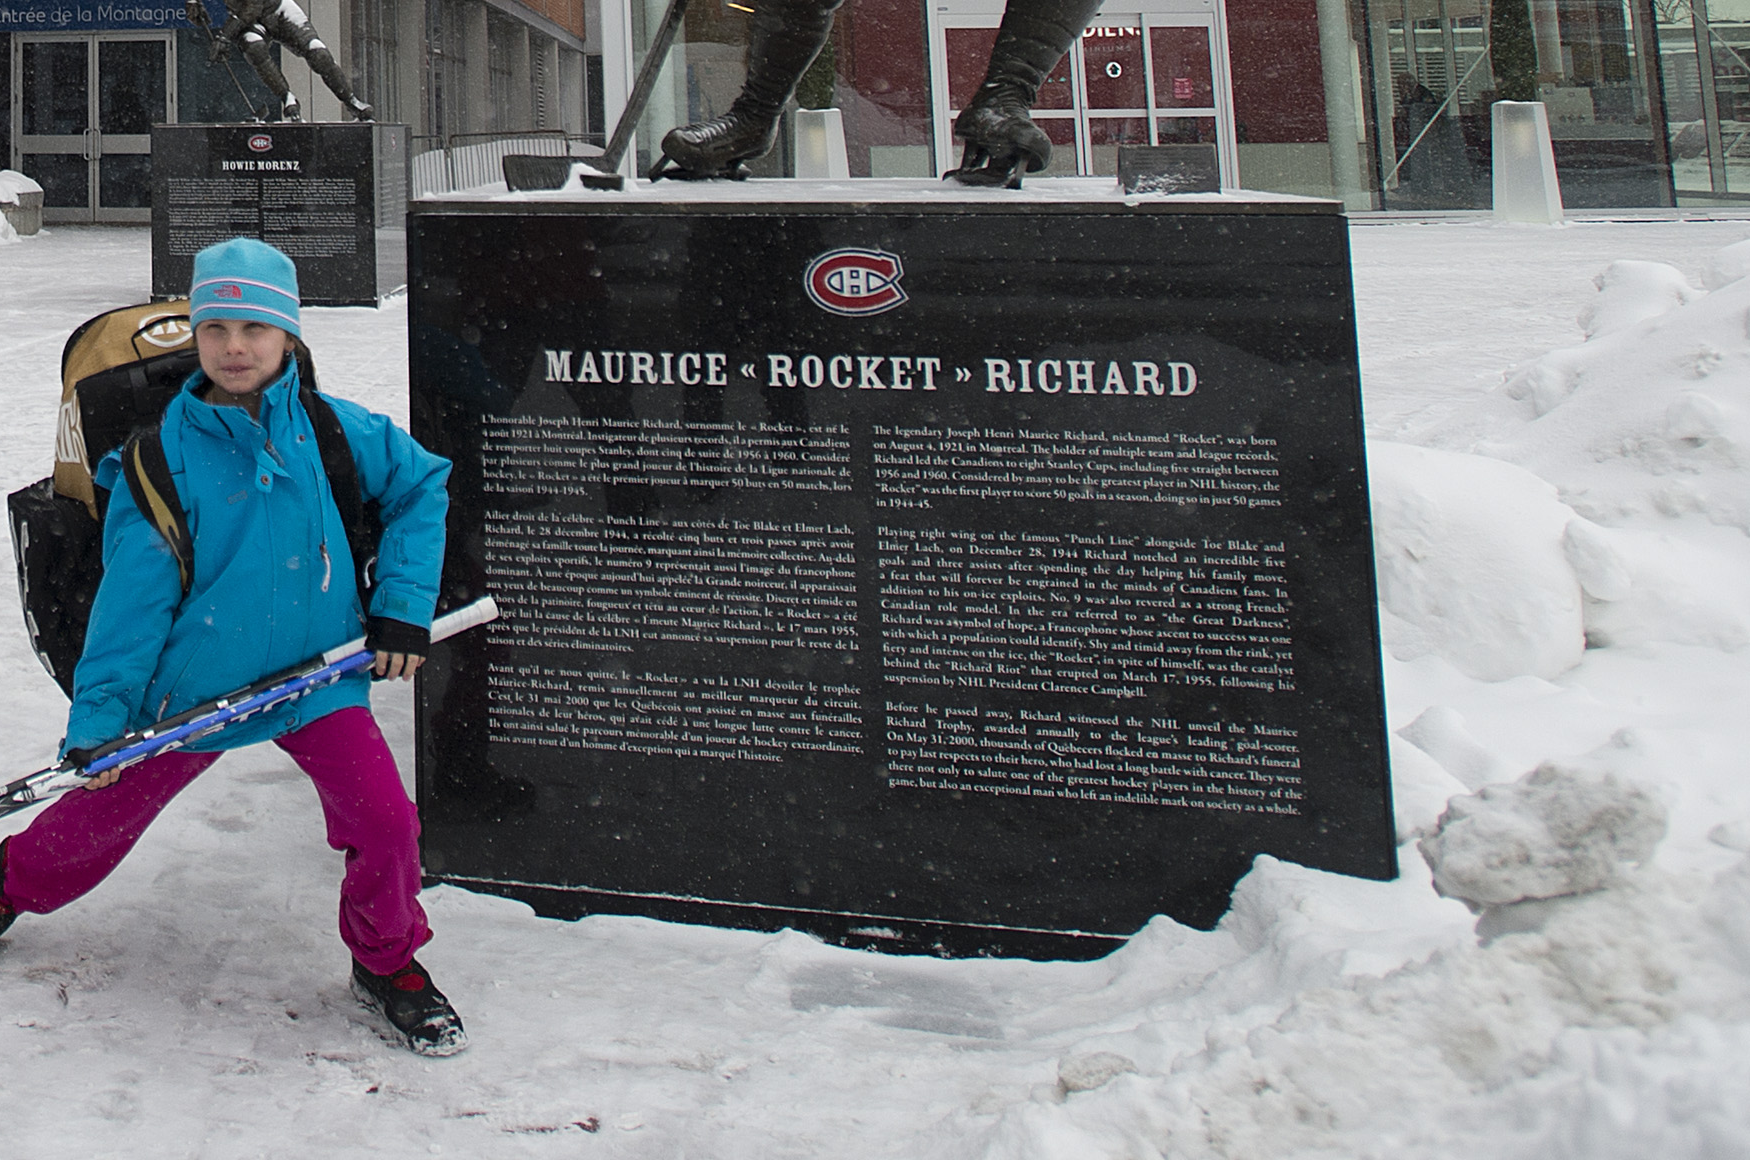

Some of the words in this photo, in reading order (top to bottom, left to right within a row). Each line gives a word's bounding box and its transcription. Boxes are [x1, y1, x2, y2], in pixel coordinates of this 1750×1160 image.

[51, 6, 72, 23] de
[77, 5, 92, 22] la
[97, 5, 187, 26] Montagne
[222, 160, 256, 171] HOWIE
[257, 160, 300, 172] MORENZ
[545, 350, 728, 386] MAURICE
[767, 354, 942, 391] ROCKET
[984, 358, 1198, 397] RICHARD
[538, 415, 569, 428] Joseph
[572, 417, 598, 426] Henri
[602, 417, 639, 428] Maurice
[684, 420, 734, 430] surnommé
[736, 421, 746, 431] le
[759, 422, 792, 432] Rocket
[808, 424, 822, 433] est
[825, 424, 837, 433] né
[840, 424, 849, 434] le
[872, 425, 891, 435] The
[894, 426, 943, 439] legendary
[946, 427, 980, 440] Joseph
[984, 428, 1014, 438] Henri
[1018, 429, 1060, 439] Maurice
[1111, 432, 1170, 442] nicknamed
[1250, 435, 1277, 445] born
[889, 440, 923, 453] August
[966, 442, 976, 452] in
[1030, 444, 1050, 454] The
[1052, 445, 1086, 455] holder
[1088, 446, 1101, 455] of
[1102, 446, 1145, 459] multiple
[1148, 449, 1174, 458] team
[1176, 448, 1196, 458] and
[1198, 449, 1232, 462] league
[874, 454, 913, 464] Richard
[915, 455, 930, 465] led
[932, 456, 948, 465] the
[951, 456, 1004, 467] Canadiens
[1006, 459, 1017, 468] to
[1018, 458, 1044, 471] eight
[1046, 459, 1083, 472] Stanley
[1119, 462, 1169, 475] including
[1170, 463, 1188, 473] five
[1191, 464, 1232, 477] straight
[1234, 465, 1278, 476] between
[876, 468, 900, 478] 1956
[901, 469, 920, 479] and
[951, 471, 1009, 482] Considered
[1011, 473, 1022, 485] by
[1026, 475, 1052, 486] many
[1055, 475, 1066, 484] to
[1068, 475, 1080, 484] be
[1082, 475, 1098, 485] the
[1101, 477, 1141, 489] greatest
[1143, 477, 1174, 490] player
[1176, 478, 1187, 488] in
[1189, 479, 1216, 489] NHL
[1262, 481, 1279, 491] the
[876, 497, 886, 507] in
[921, 486, 940, 494] was
[941, 485, 957, 495] the
[958, 485, 979, 495] first
[980, 486, 1011, 499] player
[1012, 488, 1024, 497] to
[1025, 490, 1052, 498] score
[1052, 489, 1066, 498] 50
[1067, 489, 1094, 502] goals
[1095, 490, 1106, 500] in
[1153, 493, 1185, 505] doing
[1198, 494, 1210, 504] in
[1211, 495, 1232, 507] just
[1232, 495, 1246, 505] 50
[1248, 498, 1281, 509] games
[886, 702, 918, 712] Before
[925, 704, 937, 714] he
[945, 705, 978, 719] passed
[1020, 710, 1061, 721] Richard
[1068, 714, 1118, 725] witnessed
[1126, 717, 1142, 727] the
[1151, 719, 1180, 729] NHL
[1188, 721, 1220, 732] unveil
[1228, 723, 1245, 733] the
[1254, 725, 1297, 737] Maurice
